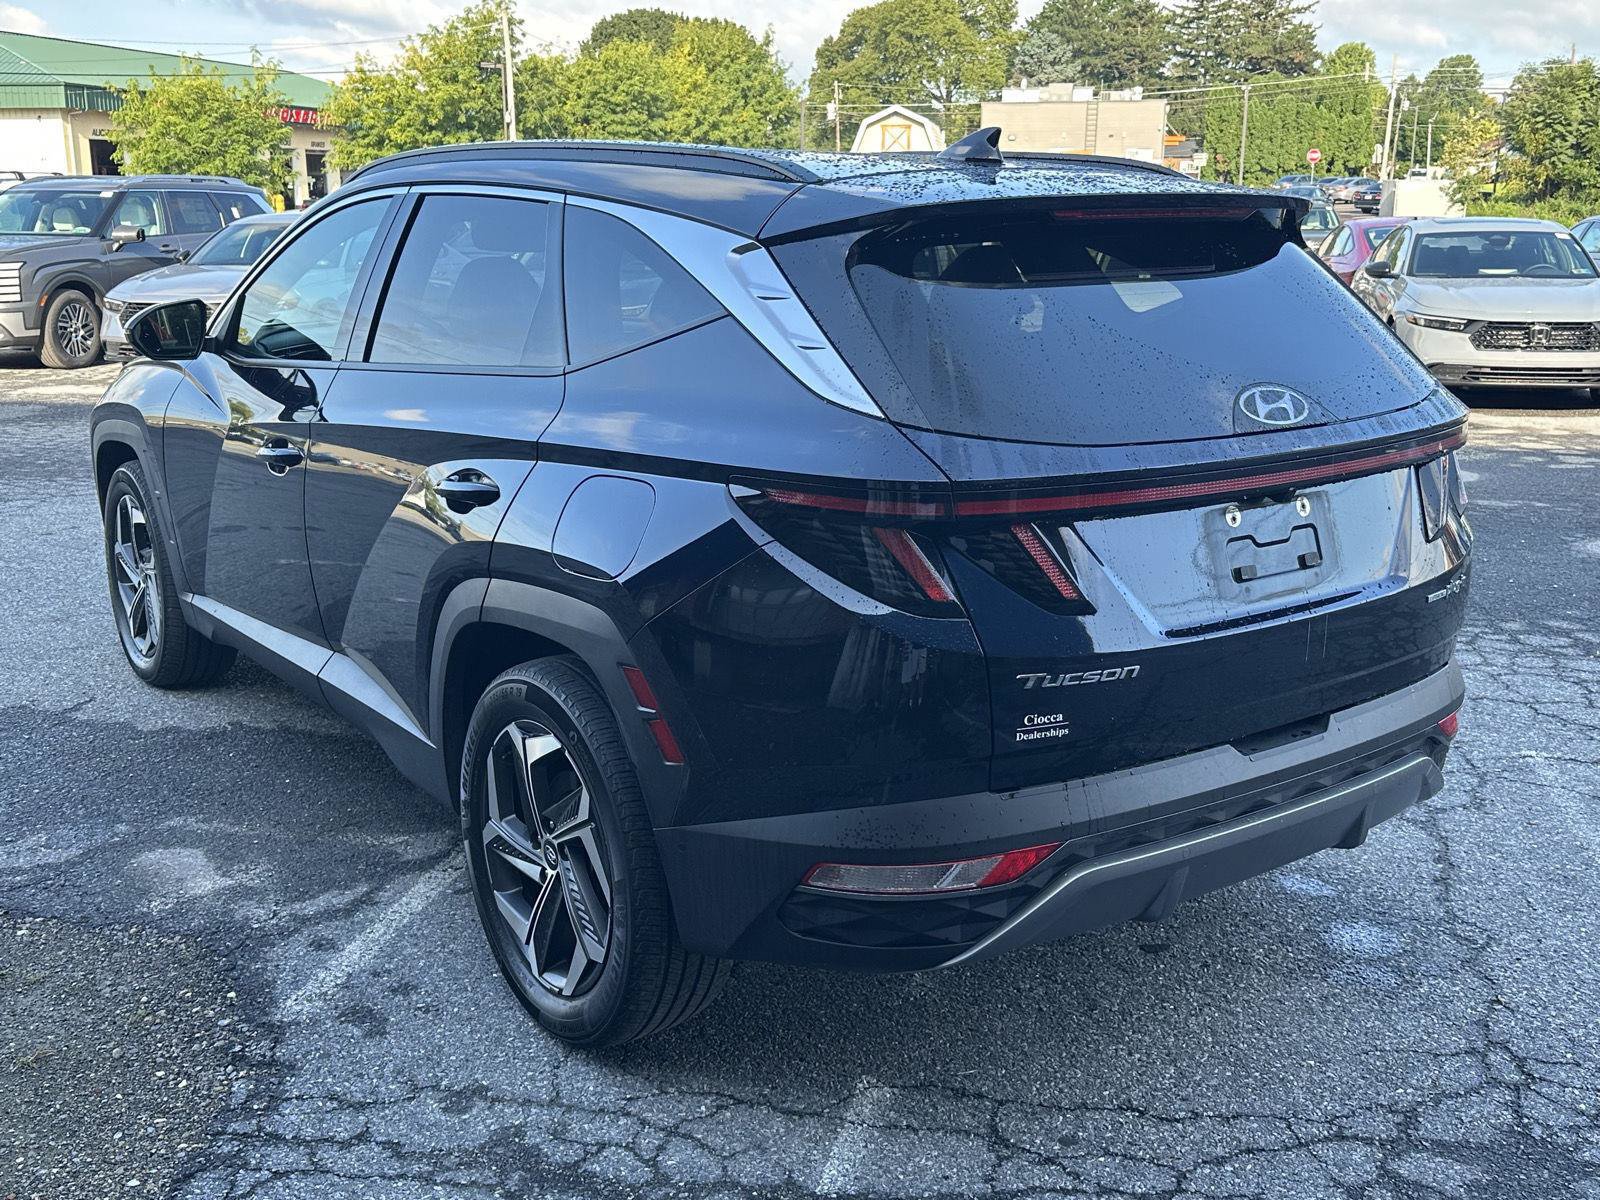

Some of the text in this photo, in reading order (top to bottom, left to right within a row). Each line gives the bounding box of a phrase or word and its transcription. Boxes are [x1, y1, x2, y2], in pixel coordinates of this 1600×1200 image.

[1016, 665, 1140, 689] TUCSON
[1024, 712, 1063, 726] Ciocca
[1015, 727, 1069, 741] Dealerships
